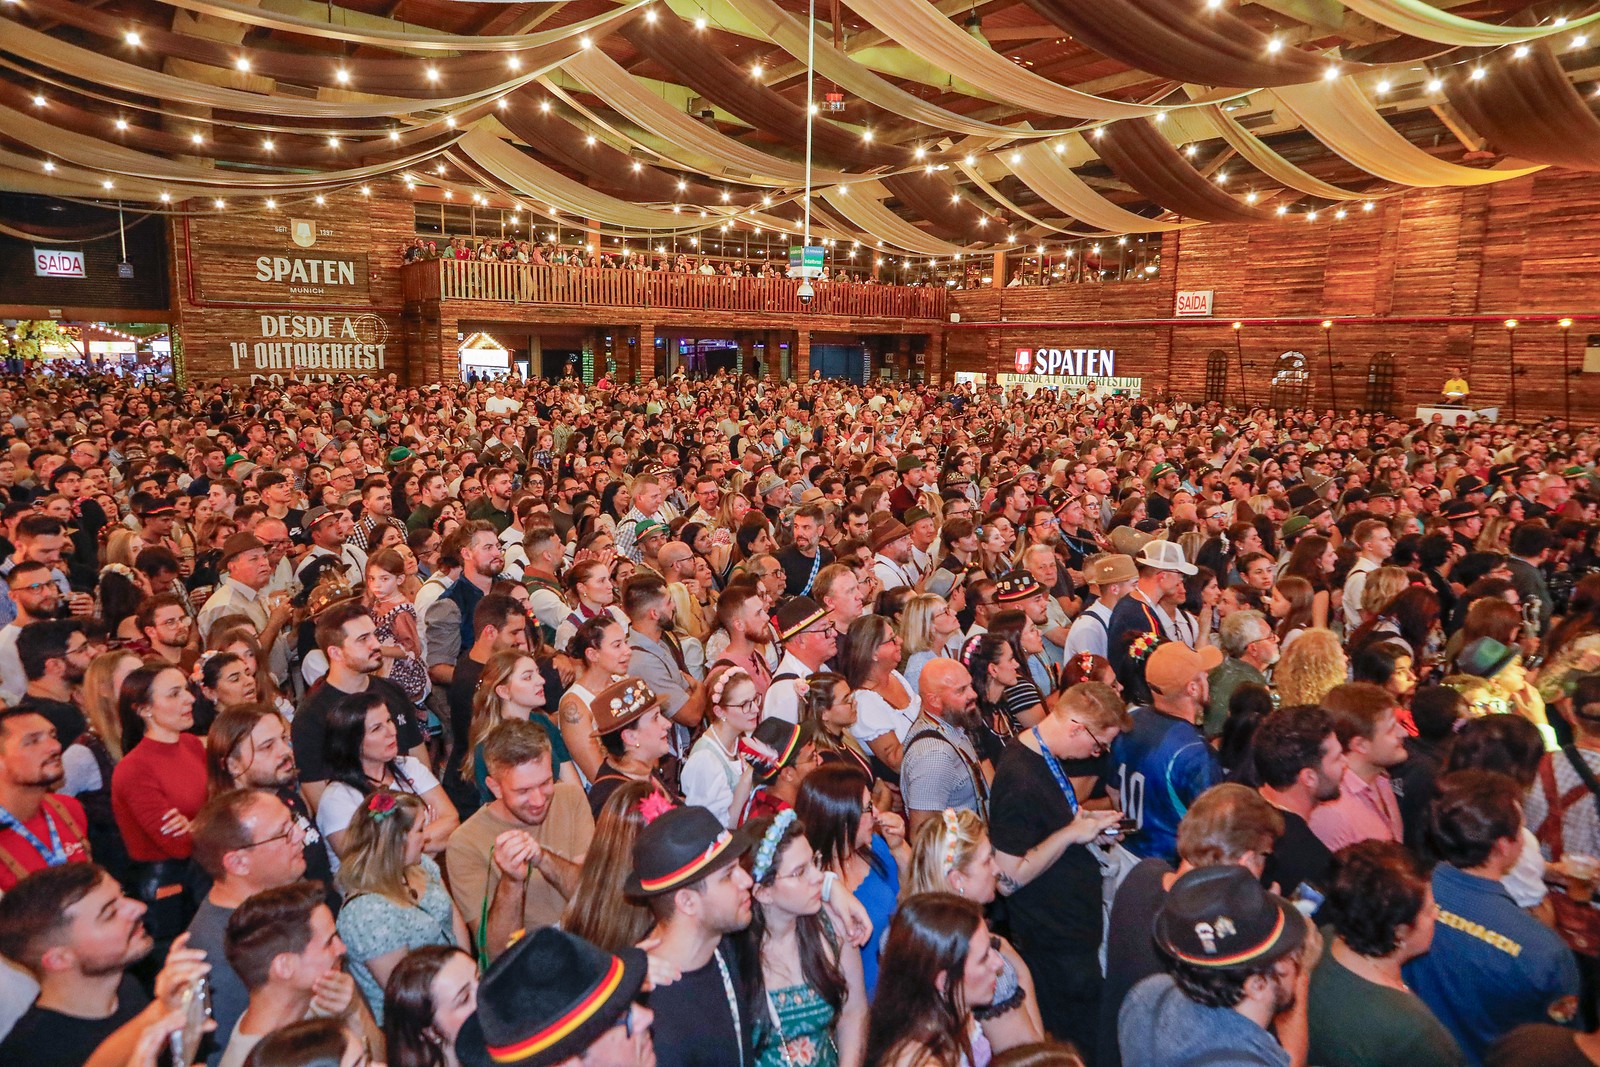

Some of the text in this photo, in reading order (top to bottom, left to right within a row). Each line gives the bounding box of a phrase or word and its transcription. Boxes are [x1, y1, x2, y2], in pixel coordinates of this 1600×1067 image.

[37, 252, 83, 272] SAÍDA
[255, 256, 355, 285] SPATEN
[1178, 292, 1207, 311] SAÍDA
[260, 315, 356, 339] DESDE A
[253, 342, 386, 370] OKTOBERFEST
[1034, 349, 1114, 376] SPATEN
[1118, 763, 1146, 830] 10
